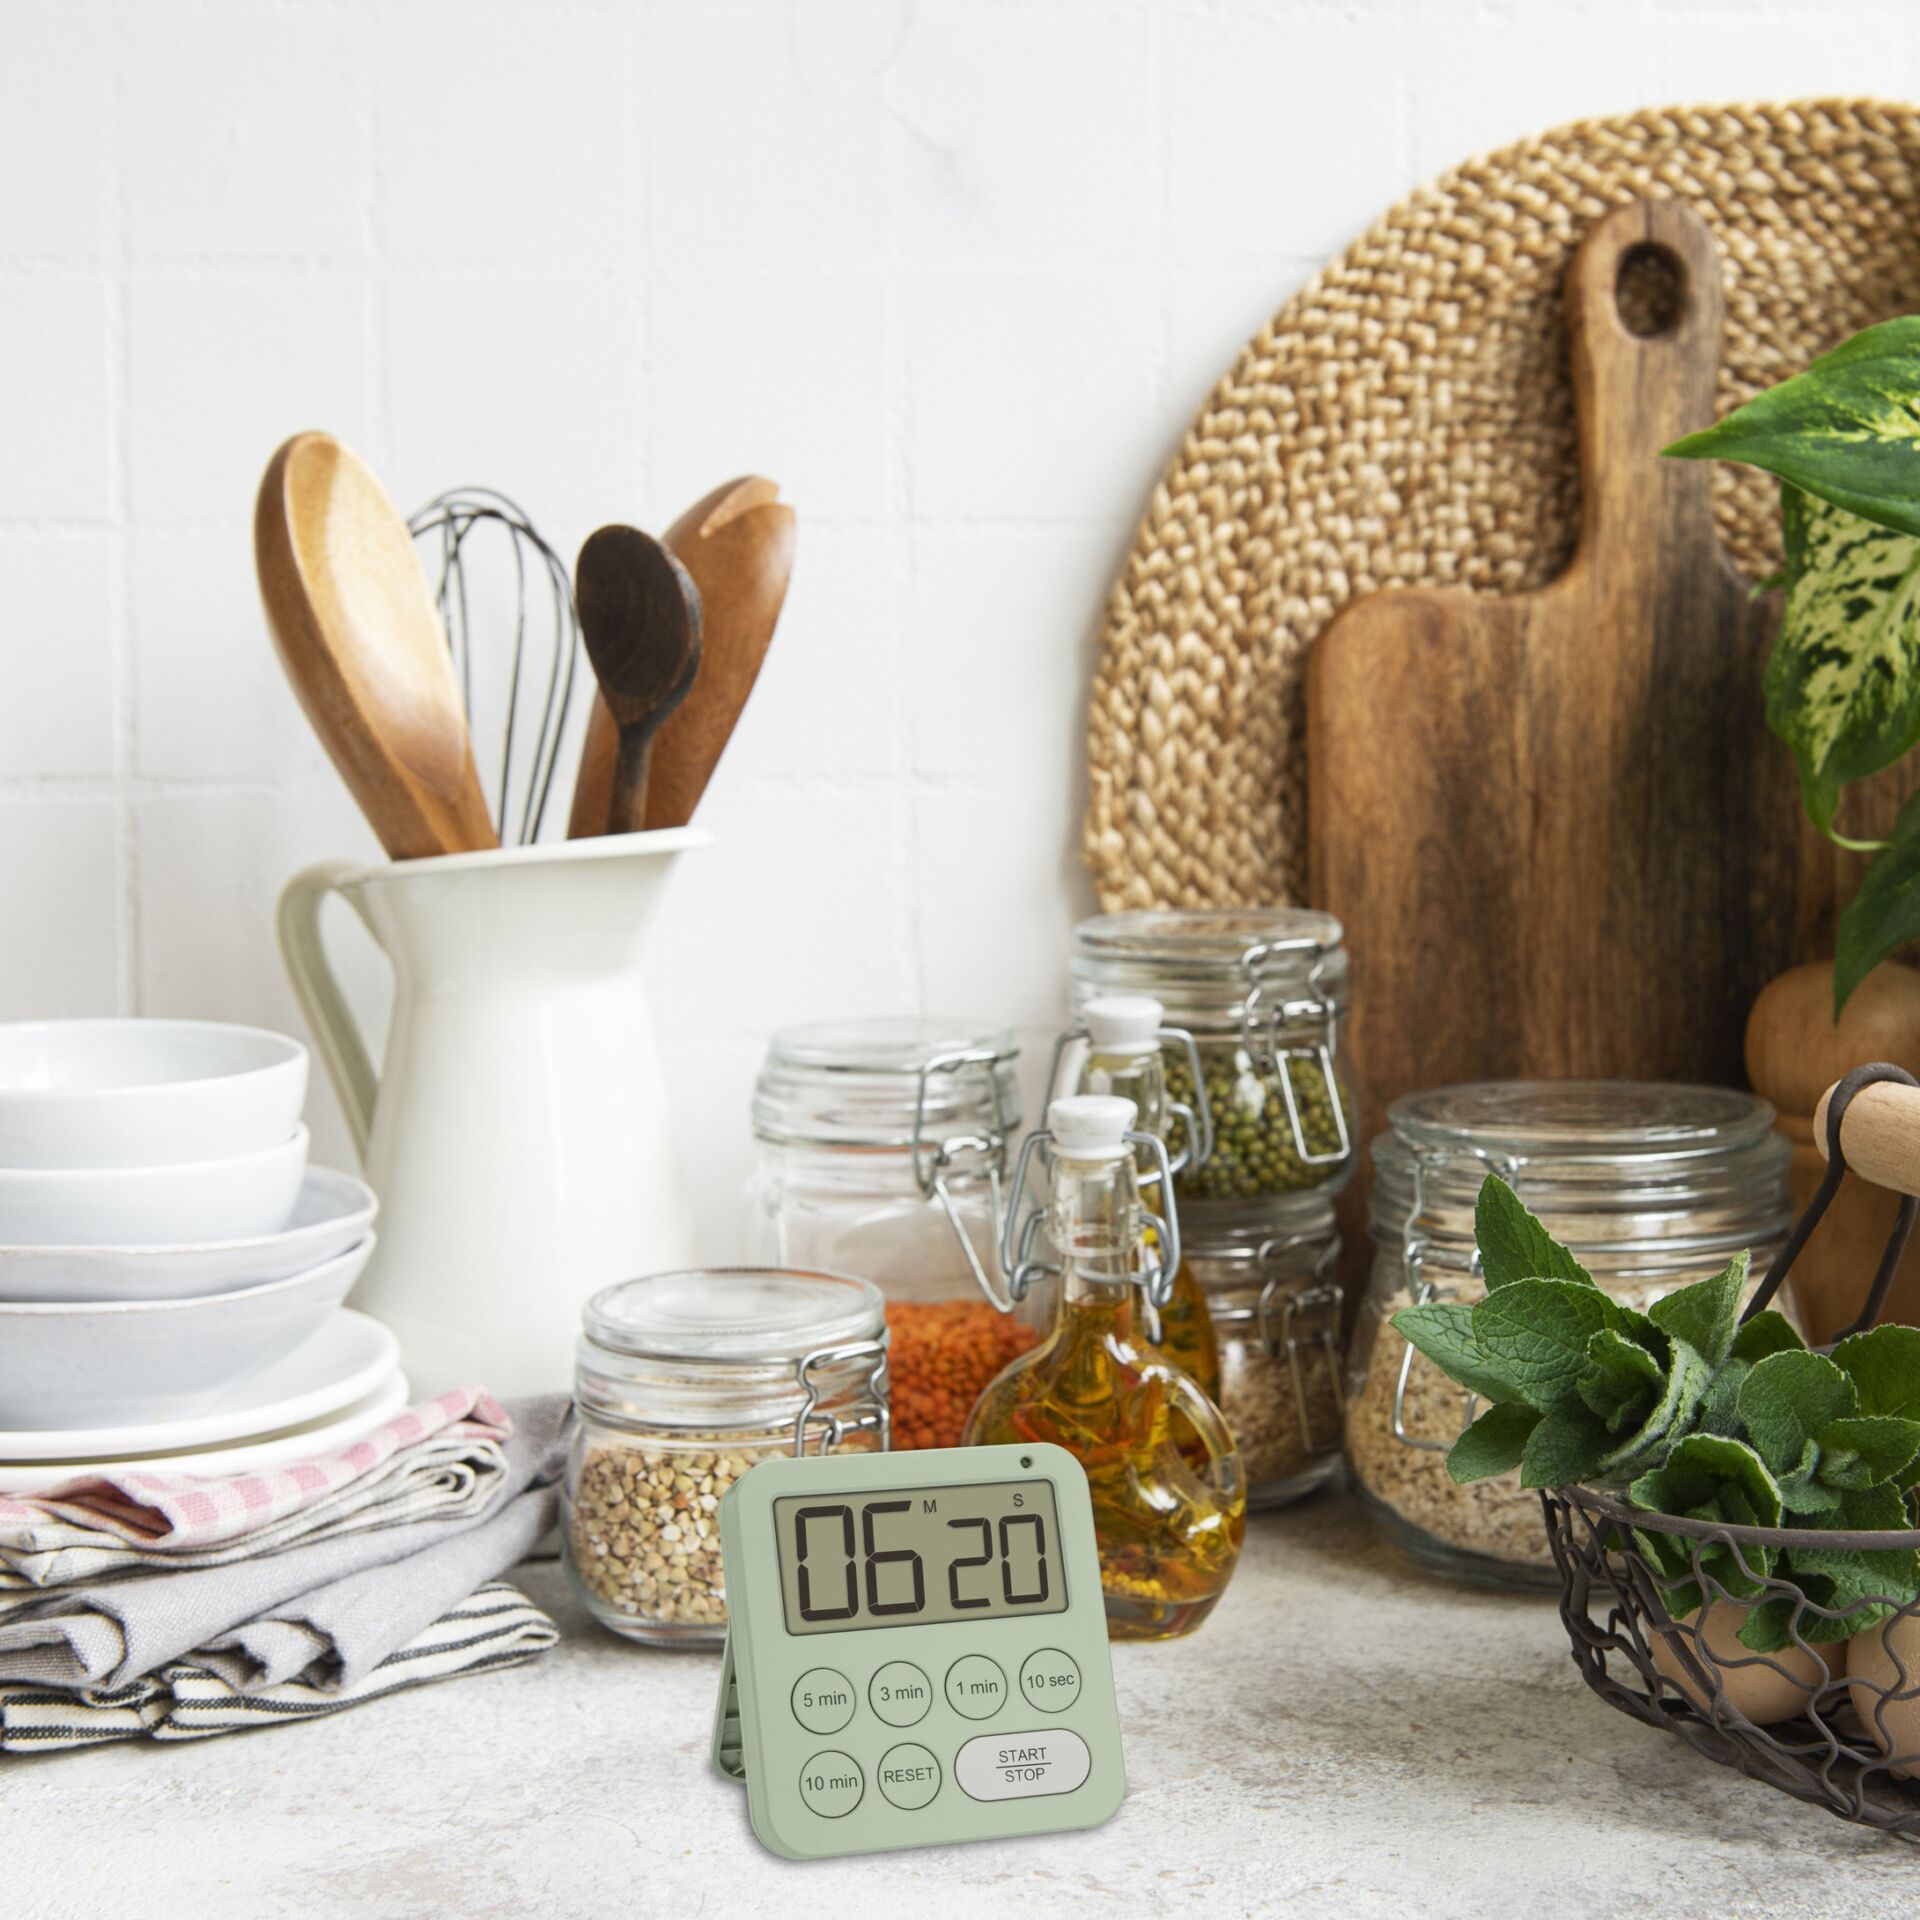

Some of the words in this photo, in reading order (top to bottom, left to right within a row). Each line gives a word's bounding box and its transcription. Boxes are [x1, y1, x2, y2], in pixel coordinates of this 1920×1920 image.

[923, 1499, 937, 1513] M
[1013, 1493, 1025, 1507] S
[795, 1500, 925, 1622] 06
[947, 1513, 1050, 1610] 20
[956, 1681, 964, 1696] 1
[970, 1679, 999, 1695] min
[1027, 1674, 1045, 1690] 10
[1048, 1672, 1075, 1688] sec
[803, 1692, 814, 1708] 5
[818, 1691, 847, 1706] min
[880, 1686, 890, 1702] 3
[895, 1685, 924, 1700] min
[998, 1746, 1047, 1764] START
[805, 1776, 825, 1792] 10
[829, 1774, 858, 1790] min
[883, 1766, 935, 1784] RESET
[1004, 1767, 1045, 1783] STOP
